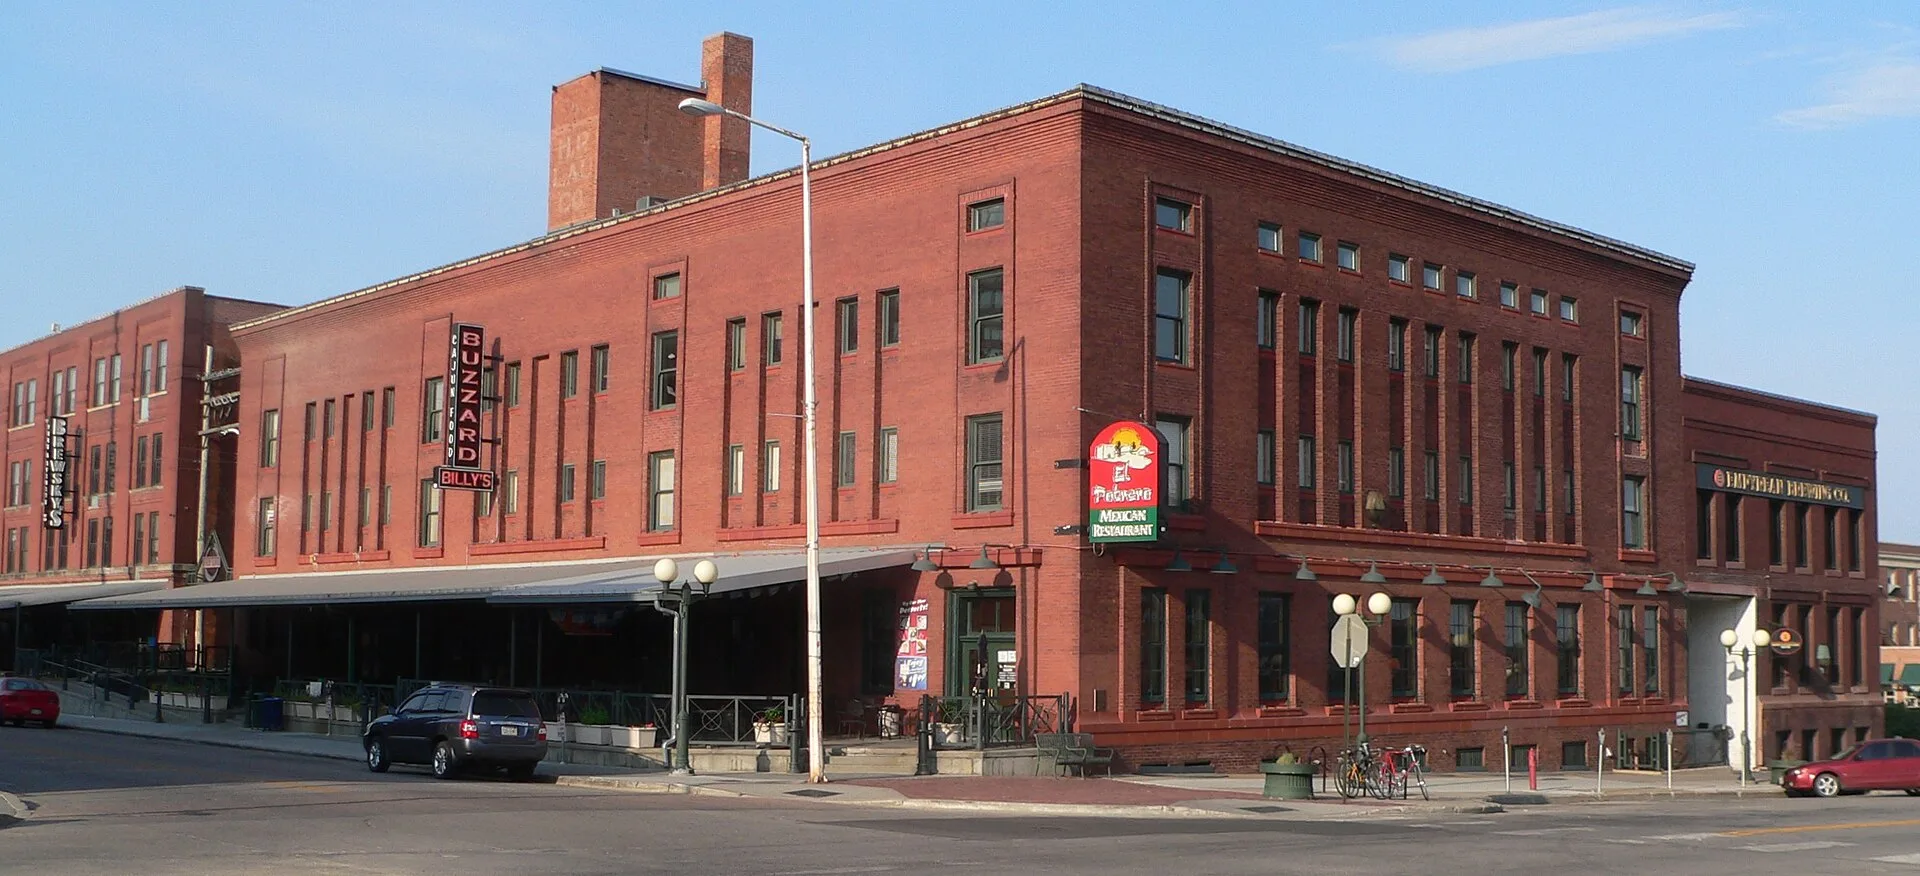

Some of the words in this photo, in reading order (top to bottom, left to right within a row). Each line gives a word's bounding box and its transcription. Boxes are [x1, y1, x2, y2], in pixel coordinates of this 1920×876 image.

[458, 331, 481, 461] BUZZARD
[49, 418, 67, 527] BREWSKY'S
[441, 471, 491, 488] BILLY'S
[1113, 461, 1131, 482] El
[1787, 480, 1831, 501] BREWING
[1099, 510, 1147, 523] MEXICAN
[1092, 524, 1153, 537] RESTAURANT
